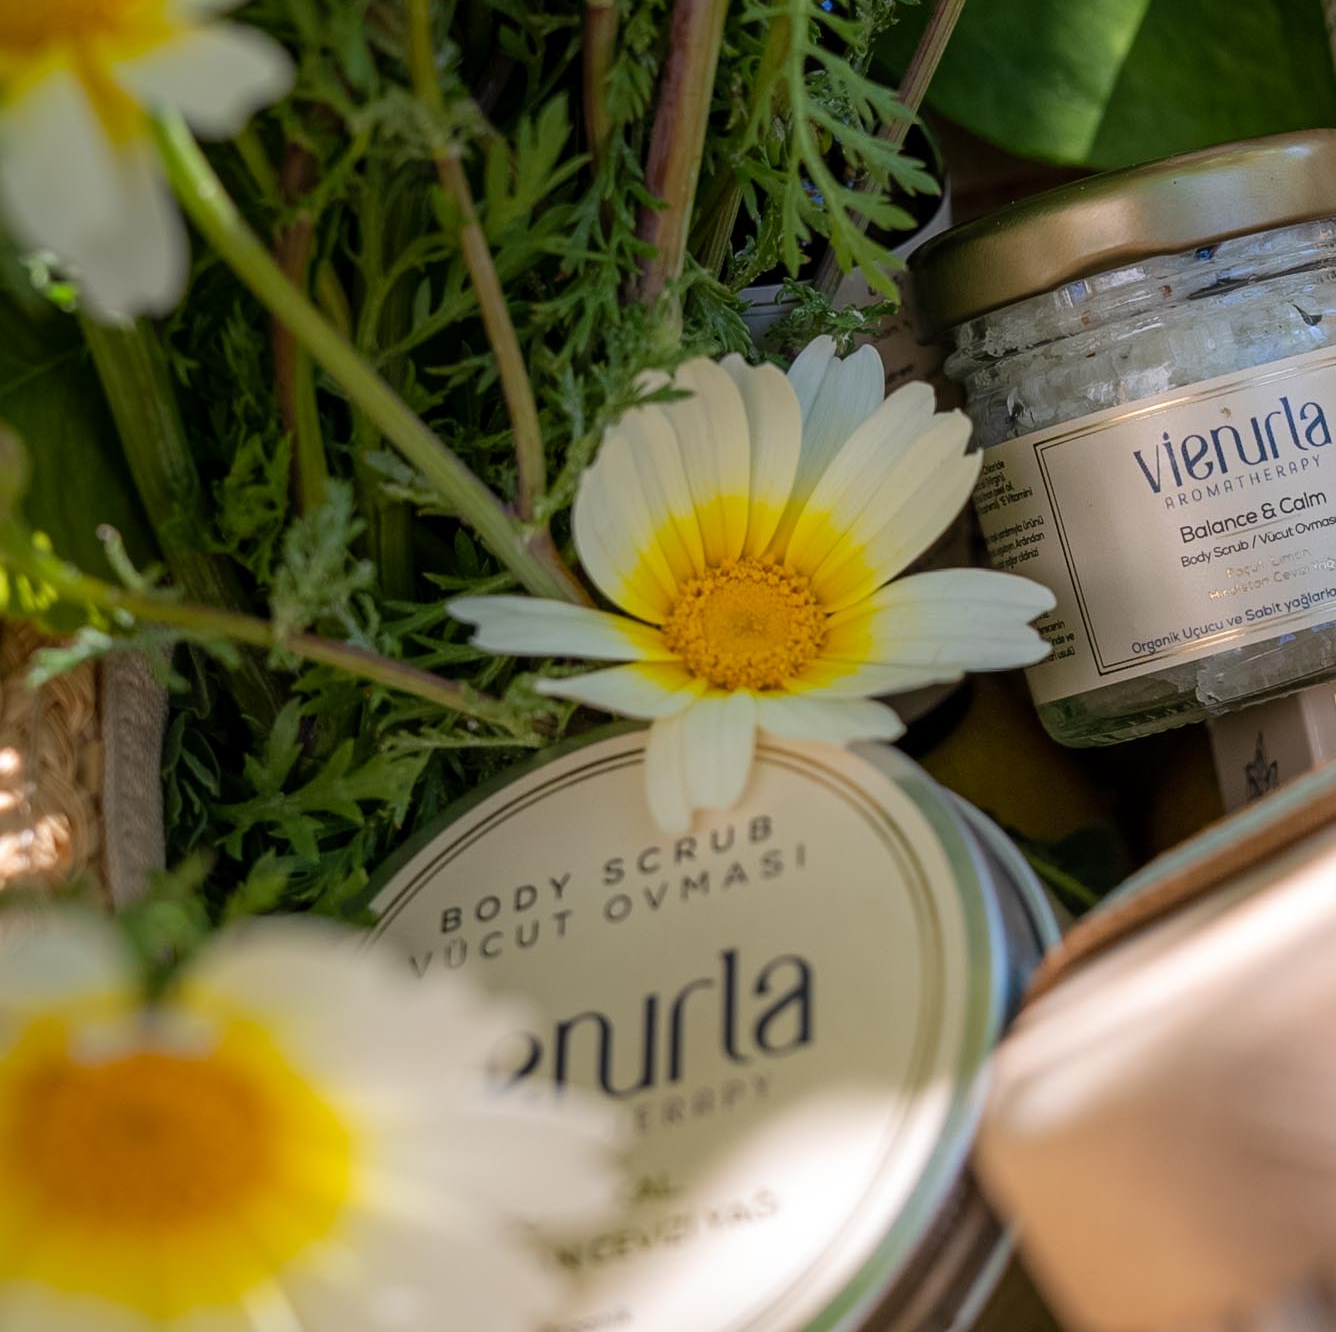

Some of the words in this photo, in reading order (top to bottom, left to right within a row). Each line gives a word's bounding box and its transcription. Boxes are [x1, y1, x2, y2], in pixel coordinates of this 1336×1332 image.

[1132, 395, 1333, 495] vienurla
[1164, 454, 1321, 511] AROMATHERAPY
[1179, 510, 1258, 544] Balance
[1260, 502, 1278, 520] &
[1279, 491, 1328, 515] Calm
[1180, 550, 1212, 568] Body
[1213, 540, 1249, 559] Scrub
[1251, 535, 1257, 549] /
[1257, 528, 1295, 545] Vücut
[1131, 630, 1181, 656] Organik
[1182, 619, 1225, 641] Uçucu
[1226, 615, 1243, 628] ve
[1244, 602, 1283, 623] Sabit
[408, 910, 574, 980] VÜCUT
[603, 843, 808, 925] OVMASI
[439, 873, 571, 935] BODY
[601, 814, 774, 888] SCRUB
[485, 946, 815, 1101] enurla
